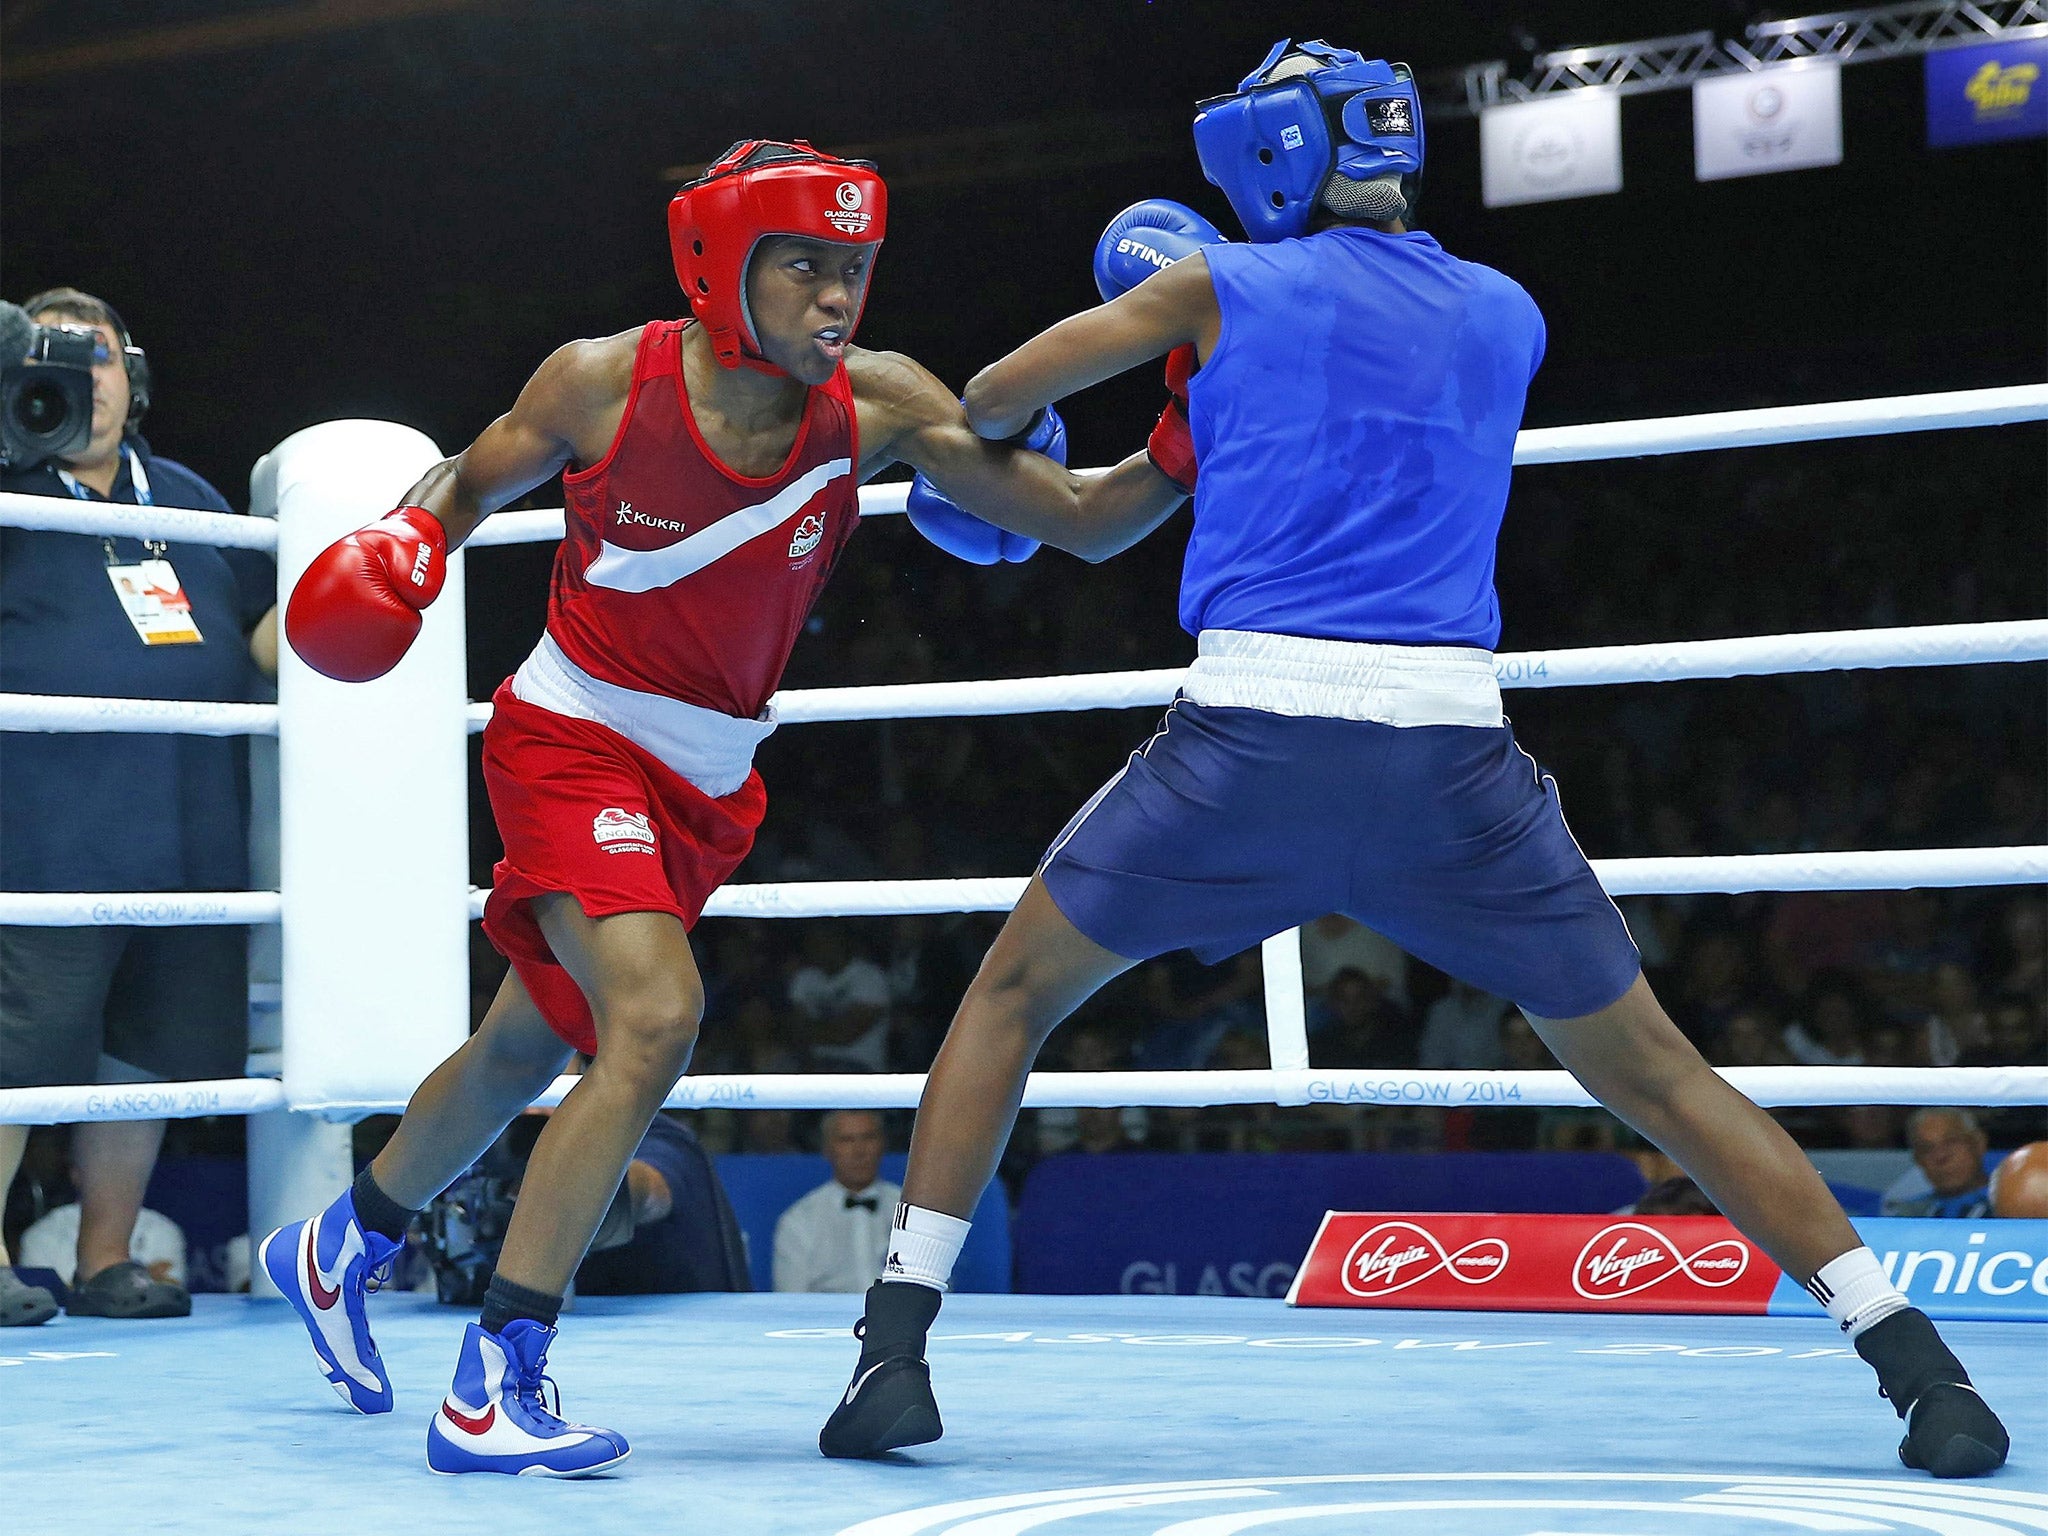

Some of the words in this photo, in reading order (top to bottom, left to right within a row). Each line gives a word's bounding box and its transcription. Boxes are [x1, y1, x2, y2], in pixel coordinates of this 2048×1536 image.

[824, 210, 859, 219] GLASGOW
[633, 511, 686, 533] KUKRI
[411, 542, 432, 587] STING
[1493, 659, 1549, 681] 2014
[596, 829, 652, 842] ENGLAND
[92, 902, 187, 922] GLASGOW
[707, 1082, 756, 1101] 2014
[1307, 1080, 1452, 1101] GLASGOW
[1462, 1081, 1522, 1101] 2014
[86, 1095, 177, 1114] GLASGOW
[184, 1091, 220, 1112] 2014
[1355, 1235, 1430, 1284] Virgin
[1455, 1255, 1501, 1267] media
[1586, 1237, 1666, 1287] Virgin
[1692, 1257, 1740, 1270] media
[1882, 1232, 2048, 1296] nic
[764, 1328, 1553, 1351] GASGOW
